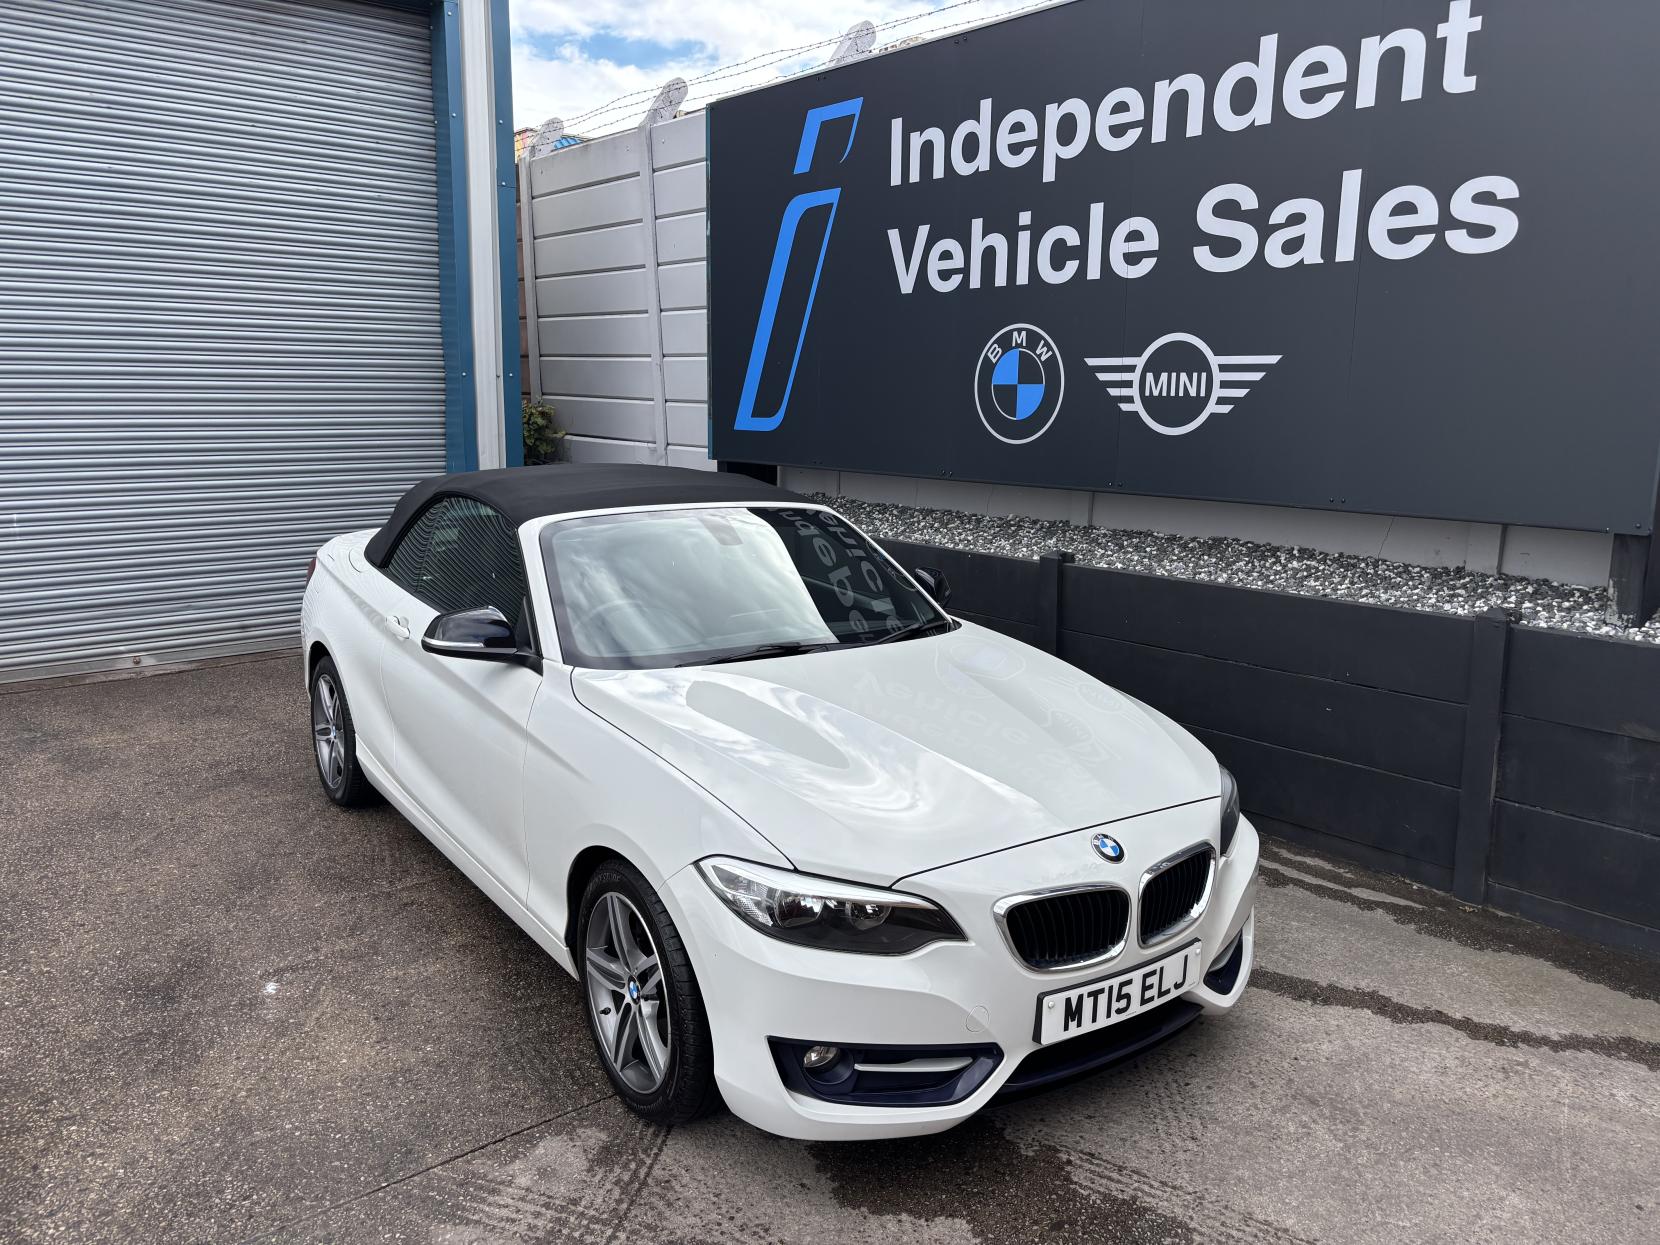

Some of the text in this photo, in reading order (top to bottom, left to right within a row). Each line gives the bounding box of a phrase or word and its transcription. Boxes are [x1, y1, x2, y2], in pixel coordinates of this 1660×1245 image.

[890, 0, 1483, 187] Independent
[887, 168, 1520, 294] Vehicle Sales
[987, 330, 1053, 364] BMW
[1144, 372, 1207, 397] MINI
[1063, 954, 1189, 1032] MT15 ELJ
